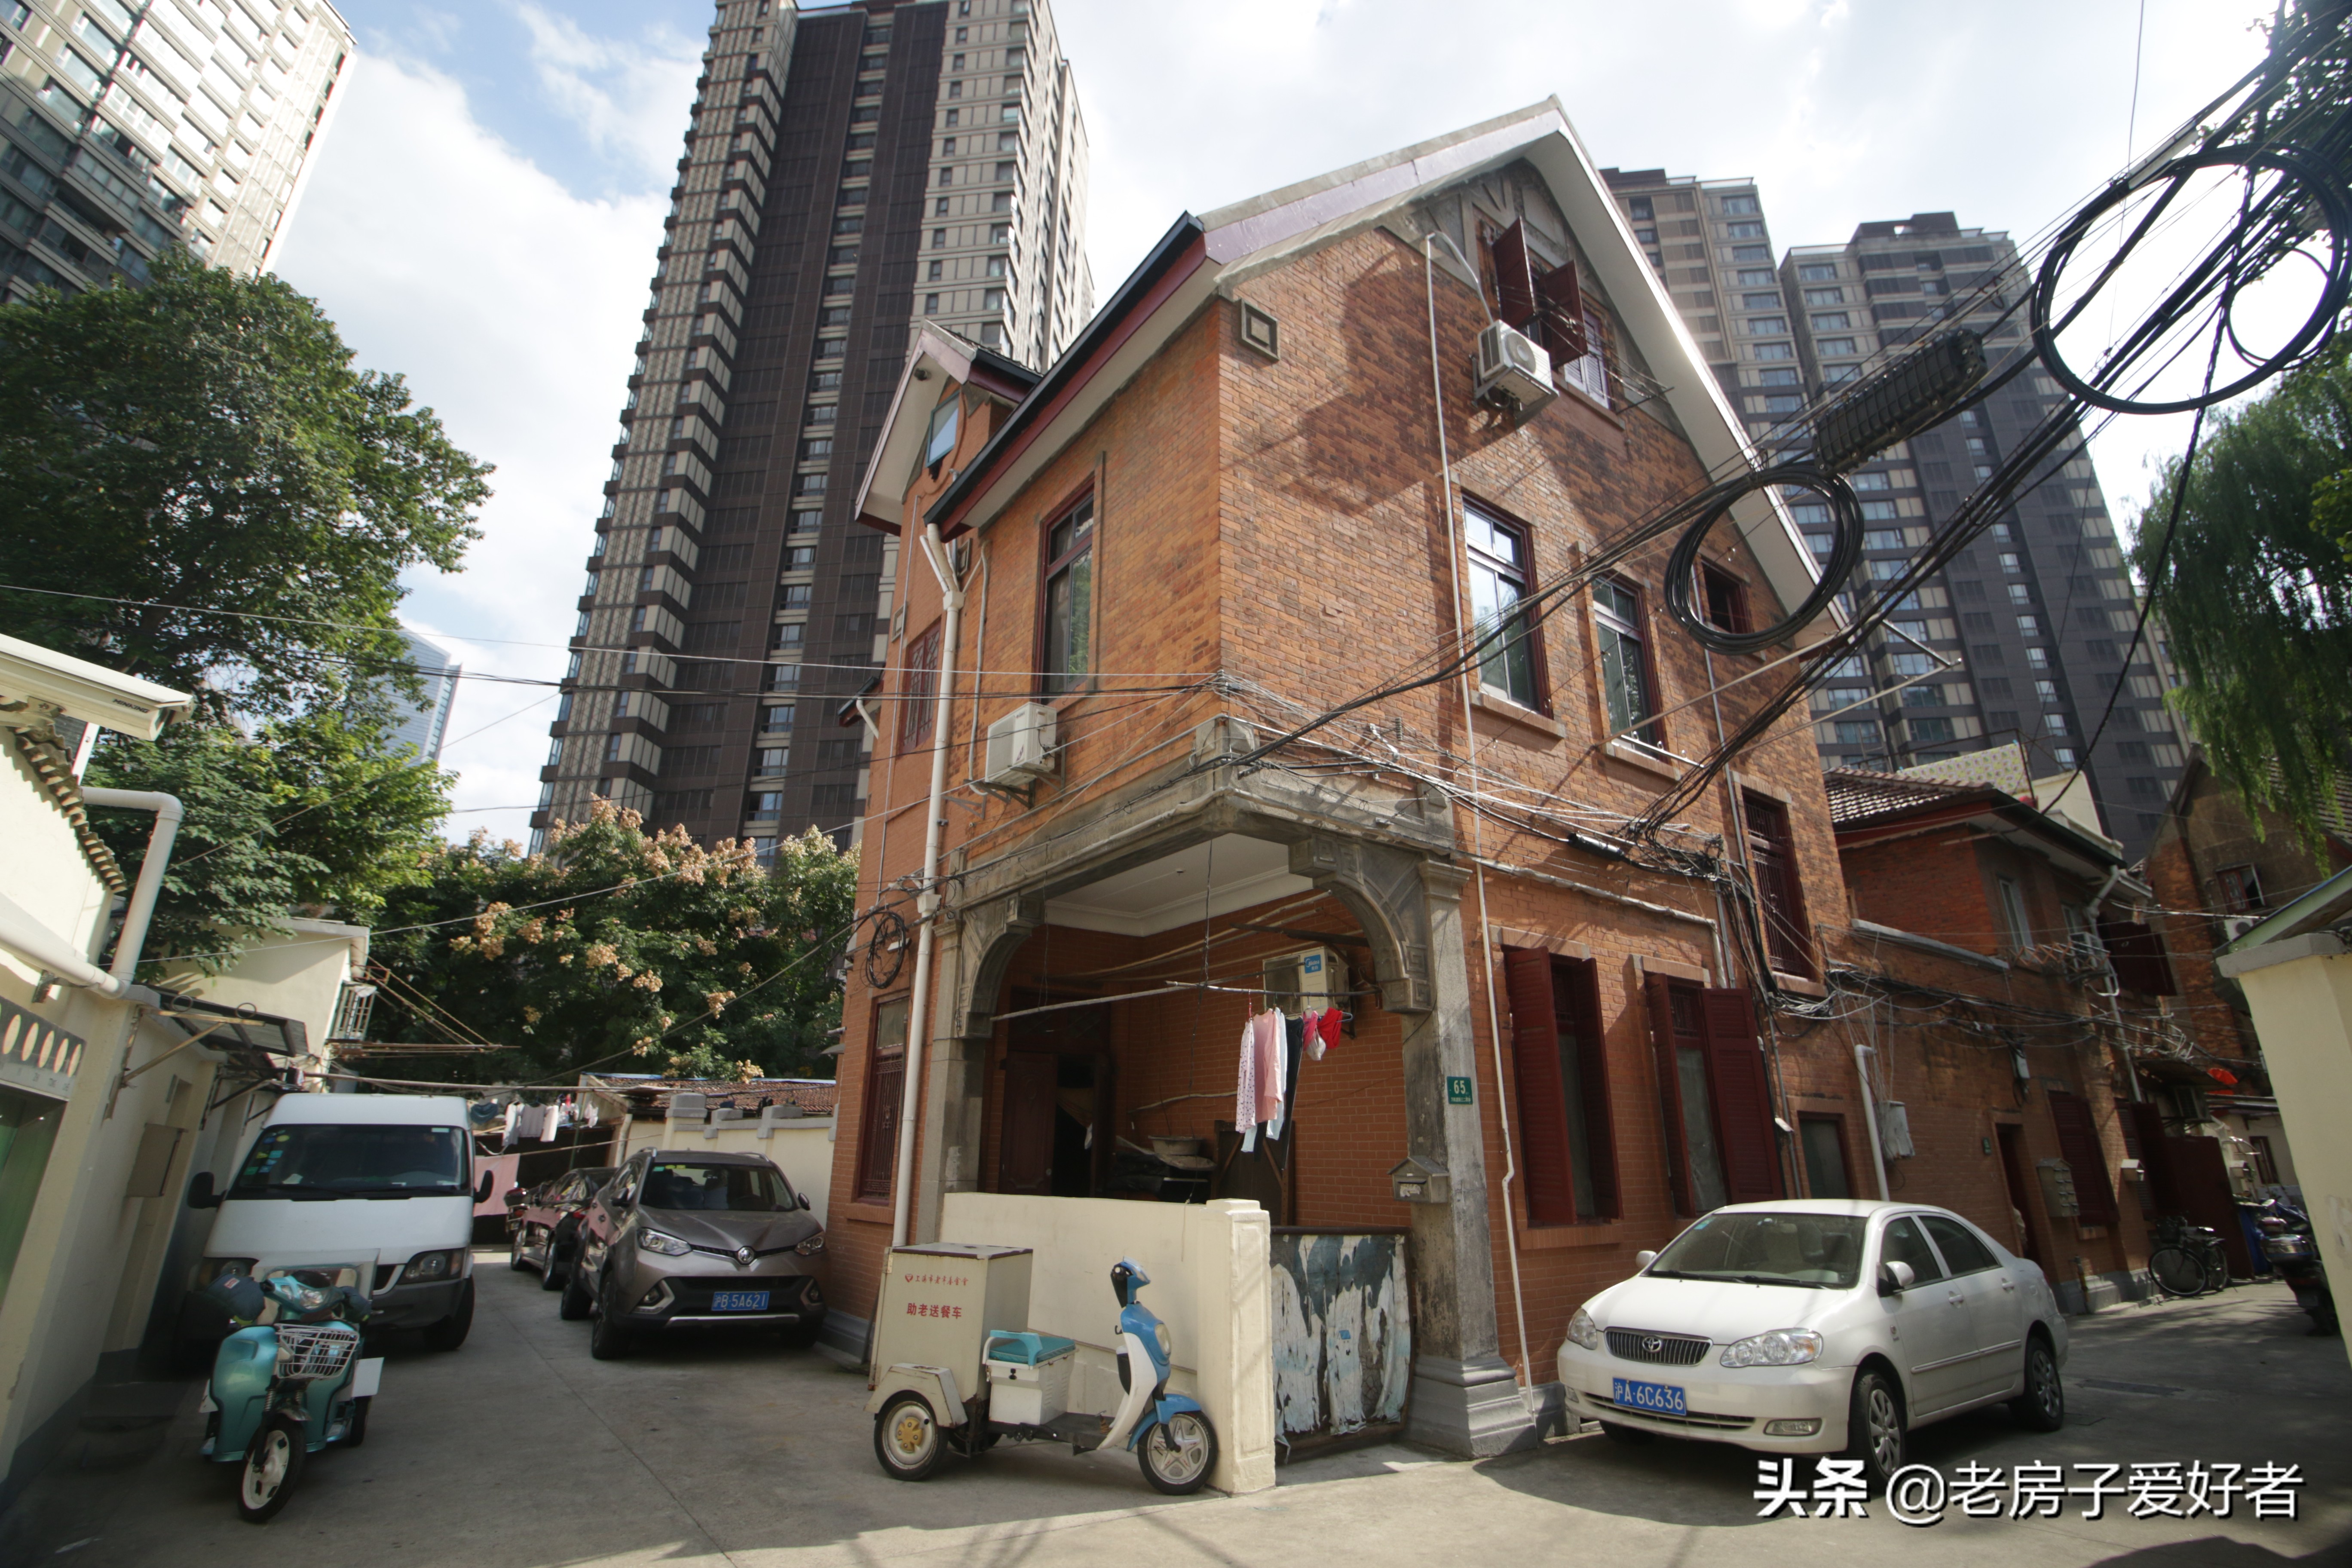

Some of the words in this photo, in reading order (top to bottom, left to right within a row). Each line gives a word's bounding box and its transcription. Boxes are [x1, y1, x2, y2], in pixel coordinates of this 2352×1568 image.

[1454, 1080, 1466, 1094] 65
[906, 1303, 962, 1320] 助老送餐车
